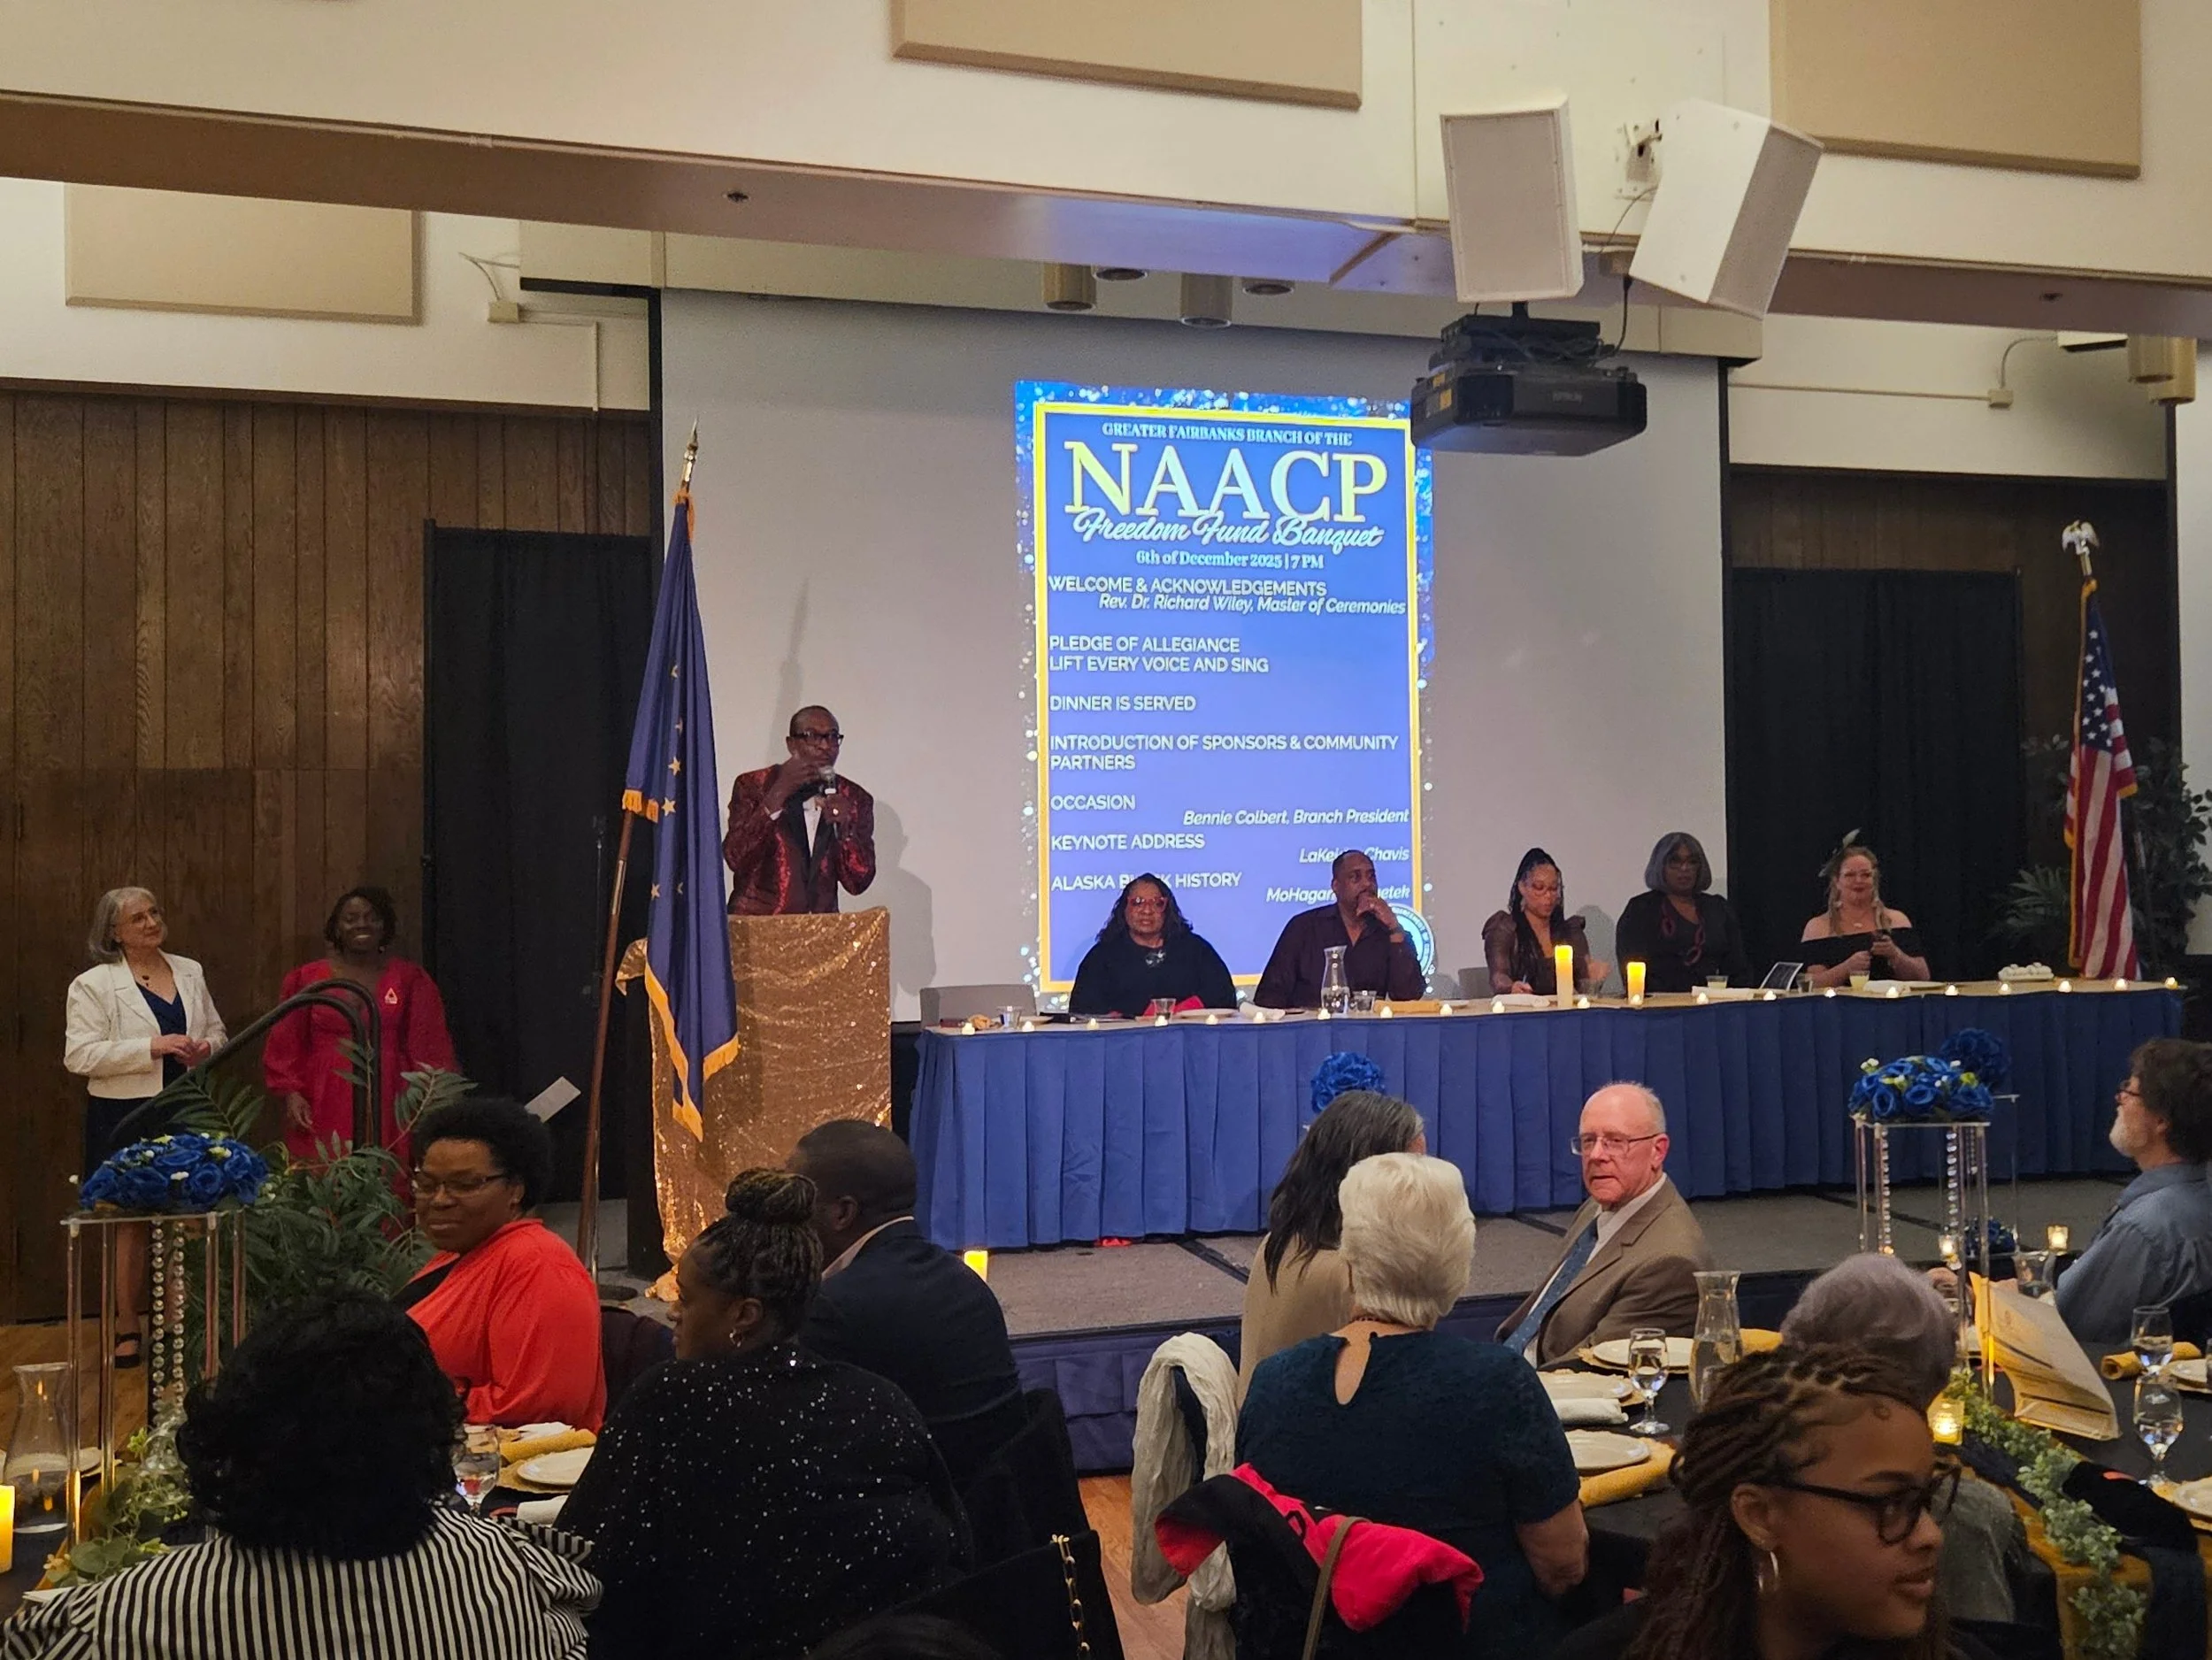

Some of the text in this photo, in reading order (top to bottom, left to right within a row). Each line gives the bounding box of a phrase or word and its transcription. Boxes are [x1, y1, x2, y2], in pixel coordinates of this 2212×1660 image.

[1102, 422, 1353, 446] GREATER FAIRBANKS BRANCH OF THE
[1064, 441, 1388, 523] NAACP
[1072, 507, 1386, 555] Freedom Fund Banquet
[1135, 549, 1161, 565] 6th
[1163, 550, 1179, 565] of
[1179, 550, 1249, 567] December
[1249, 553, 1283, 569] 2025
[1291, 555, 1302, 569] 7
[1302, 554, 1325, 569] PM
[1048, 575, 1327, 596] WELCOME & ACKNOWLEDGEMENTS
[1099, 593, 1128, 610] Rev.
[1131, 594, 1150, 610] Dr.
[1153, 595, 1210, 611] Richard
[1257, 596, 1306, 612] Master
[1308, 597, 1326, 616] of
[1326, 597, 1406, 614] Ceremonies
[1049, 635, 1240, 653] PLEDGE OF ALLEGIANCE
[1049, 656, 1269, 672] LIFT EVERY VOICE AND SING
[1049, 696, 1196, 711] DINNER IS SERVED
[1050, 734, 1399, 750] INTRODUCTION OF SPONSORS & COMMUNITY
[1050, 754, 1136, 771] PARTNERS
[1049, 794, 1136, 811] OCCASION
[1183, 810, 1233, 826] Bennie
[1293, 809, 1343, 824] Branch
[1346, 808, 1409, 823] President
[1051, 833, 1206, 850] KEYNOTE ADDRESS
[1363, 846, 1409, 861] Chavis
[1051, 874, 1116, 891] ALASKA
[1175, 872, 1242, 888] HISTORY
[1266, 887, 1337, 905] MoHagan
